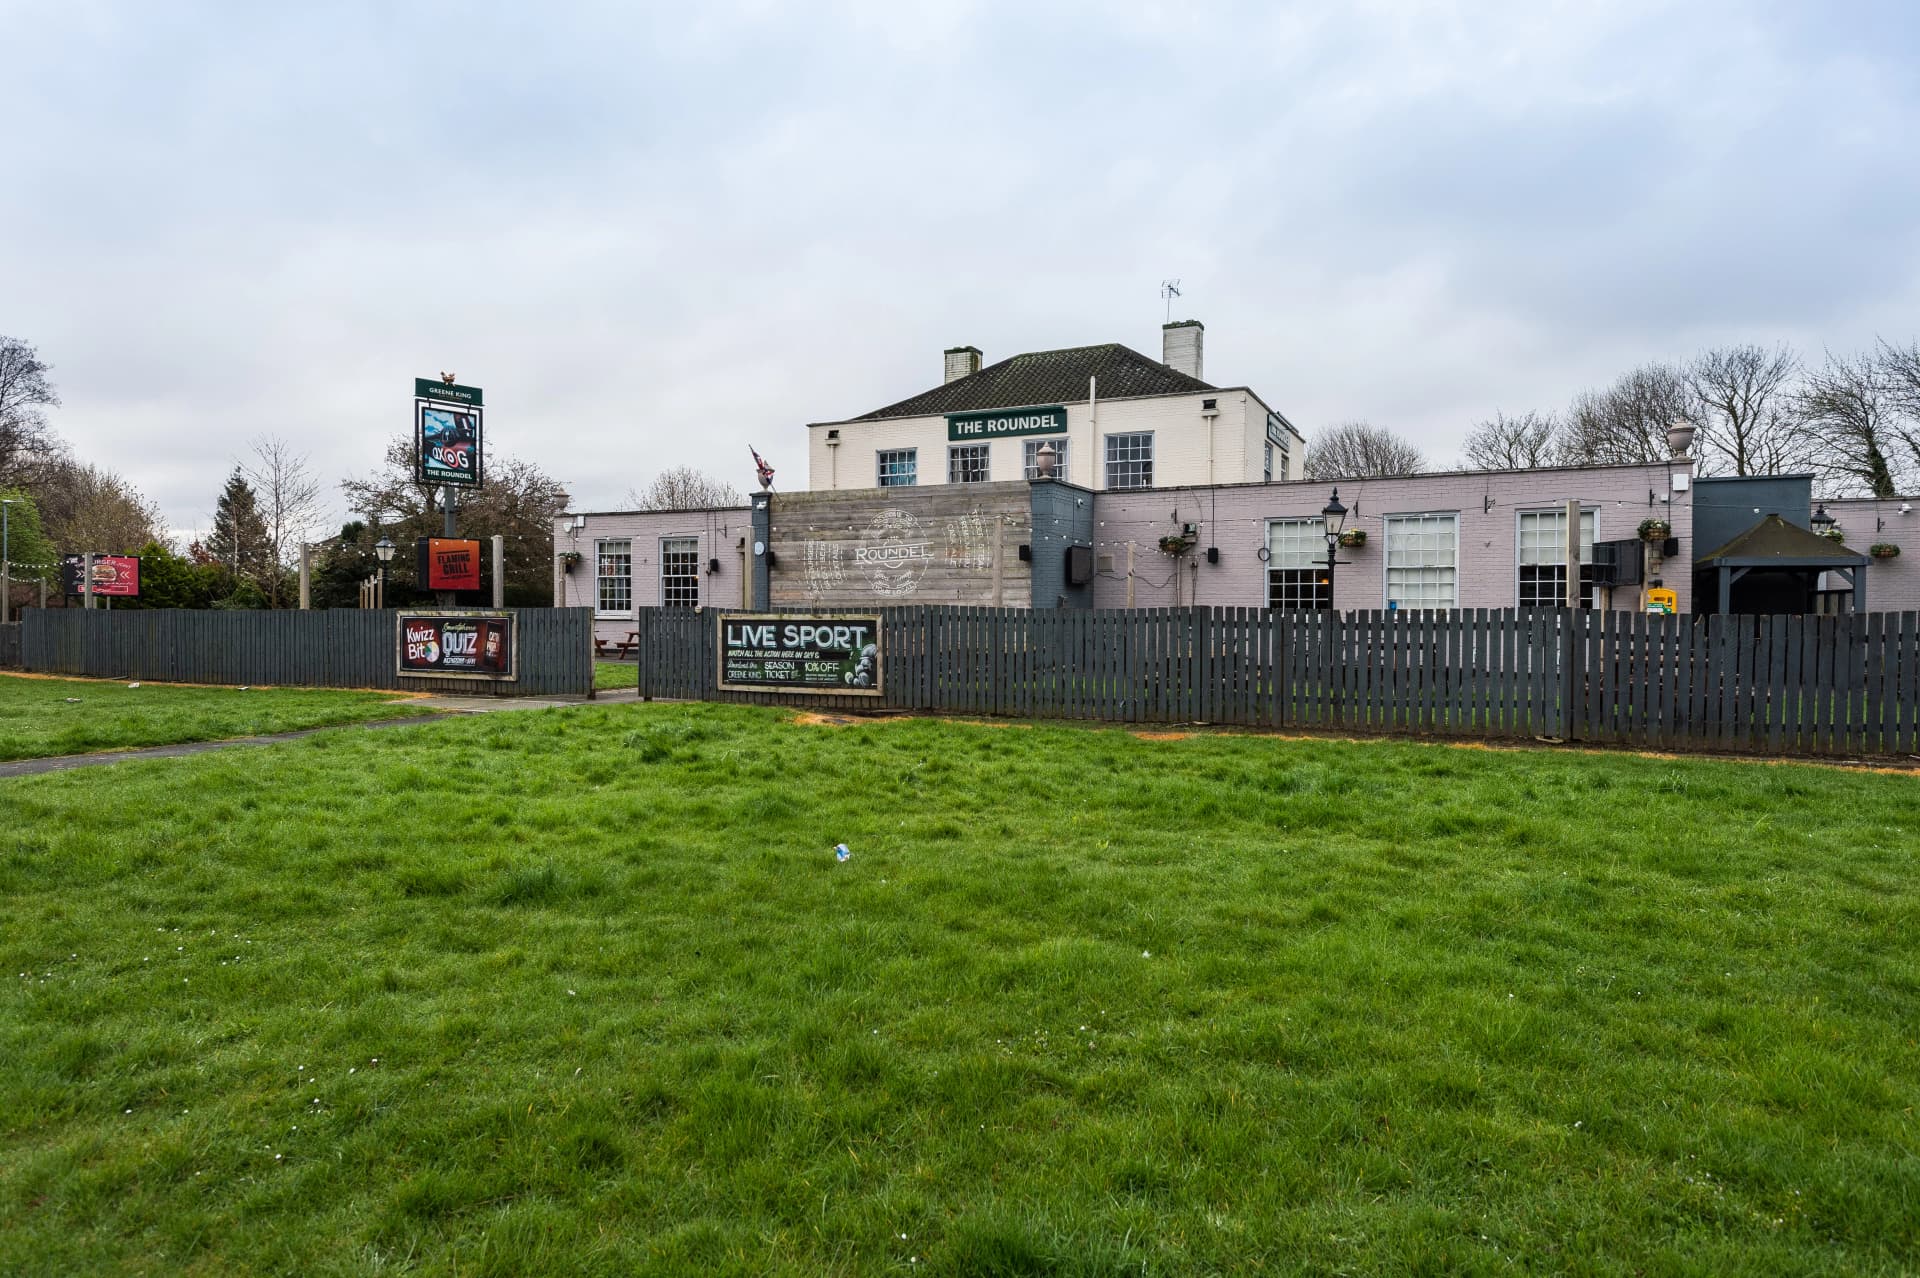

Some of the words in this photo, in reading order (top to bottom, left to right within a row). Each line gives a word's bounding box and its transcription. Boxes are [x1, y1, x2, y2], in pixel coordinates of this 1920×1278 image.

[429, 387, 453, 396] GREENE
[455, 391, 472, 399] KING
[955, 420, 983, 434] THE
[987, 414, 1059, 432] ROUNDEL
[441, 470, 472, 479] ROUNDEL
[437, 552, 471, 565] FLAMING
[855, 544, 935, 564] ROUNDEL
[443, 562, 469, 575] GRILL
[832, 543, 844, 585] COCKTAILS
[406, 626, 434, 643] Kwizz
[727, 624, 777, 647] LIVE
[783, 624, 867, 649] SPORT
[442, 632, 478, 657] QUIZ
[408, 643, 425, 660] Bit
[764, 650, 780, 658] ACTION
[803, 651, 815, 659] SKY
[764, 661, 795, 669] SEASON
[805, 662, 819, 671] 10%
[820, 662, 840, 672] OFF
[764, 670, 790, 679] TICKET
